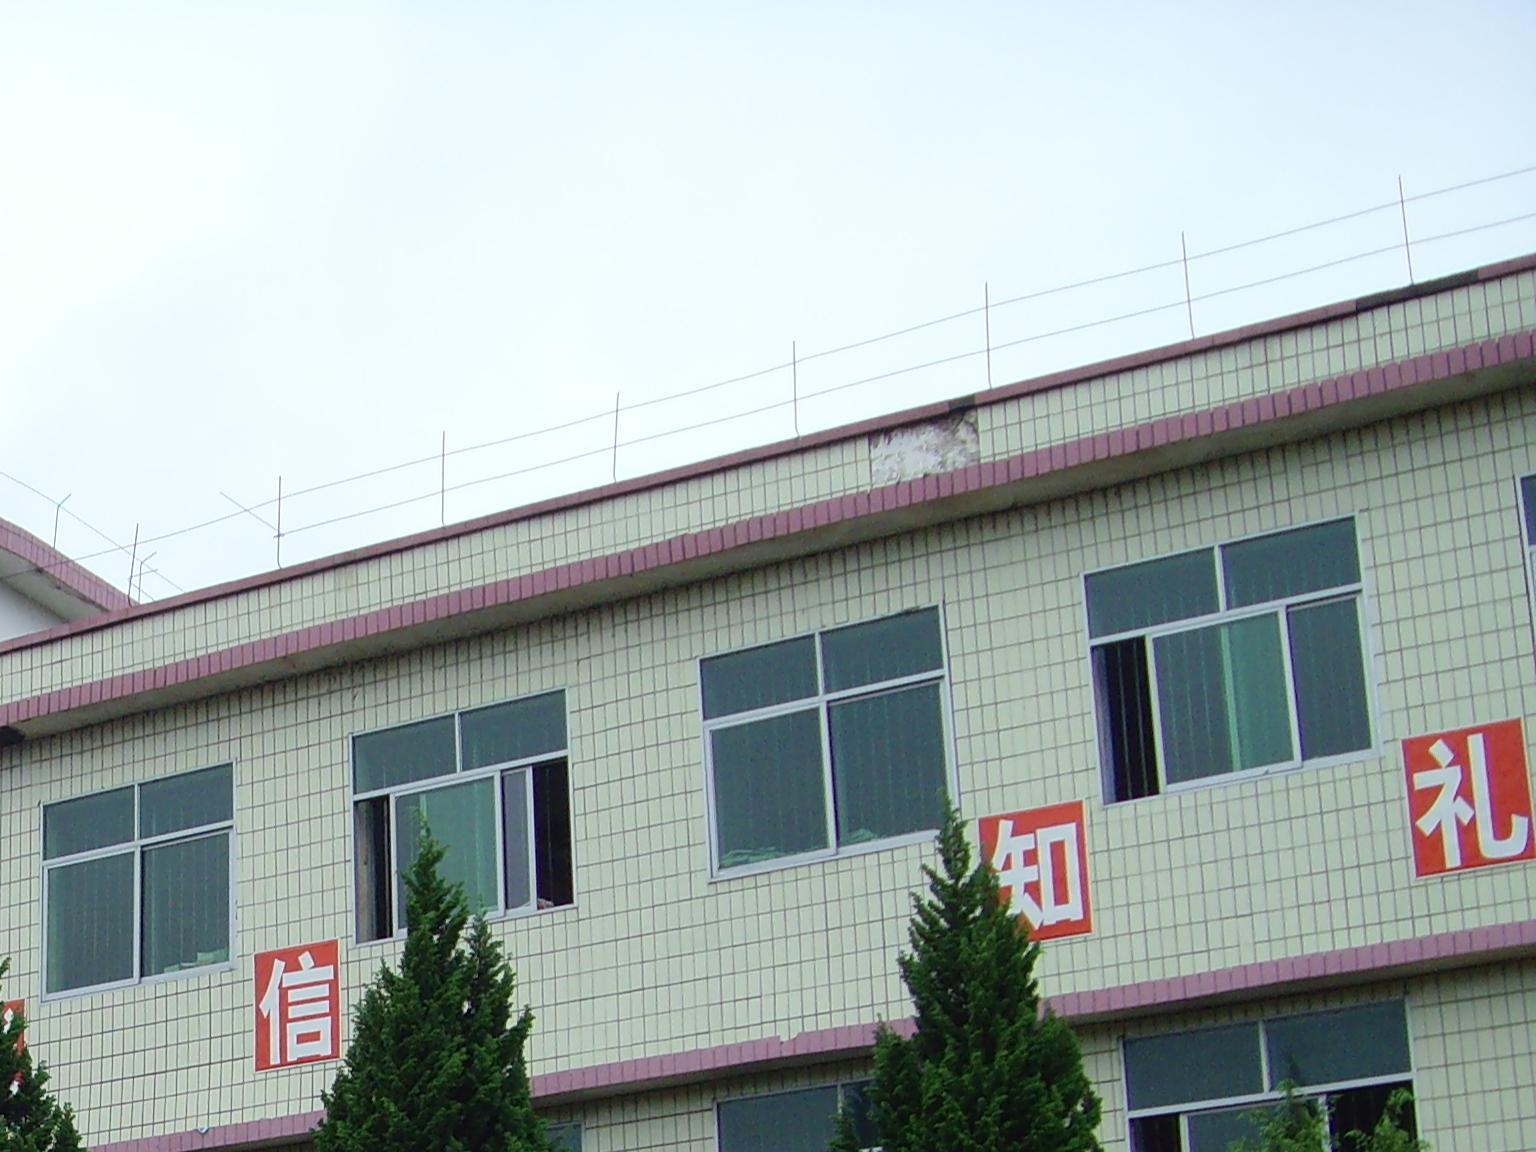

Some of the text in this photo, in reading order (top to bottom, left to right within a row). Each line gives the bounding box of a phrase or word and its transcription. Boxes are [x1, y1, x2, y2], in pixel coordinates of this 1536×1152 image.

[1413, 732, 1528, 869] 礼
[992, 819, 1084, 930] 知
[260, 951, 334, 1065] 信
